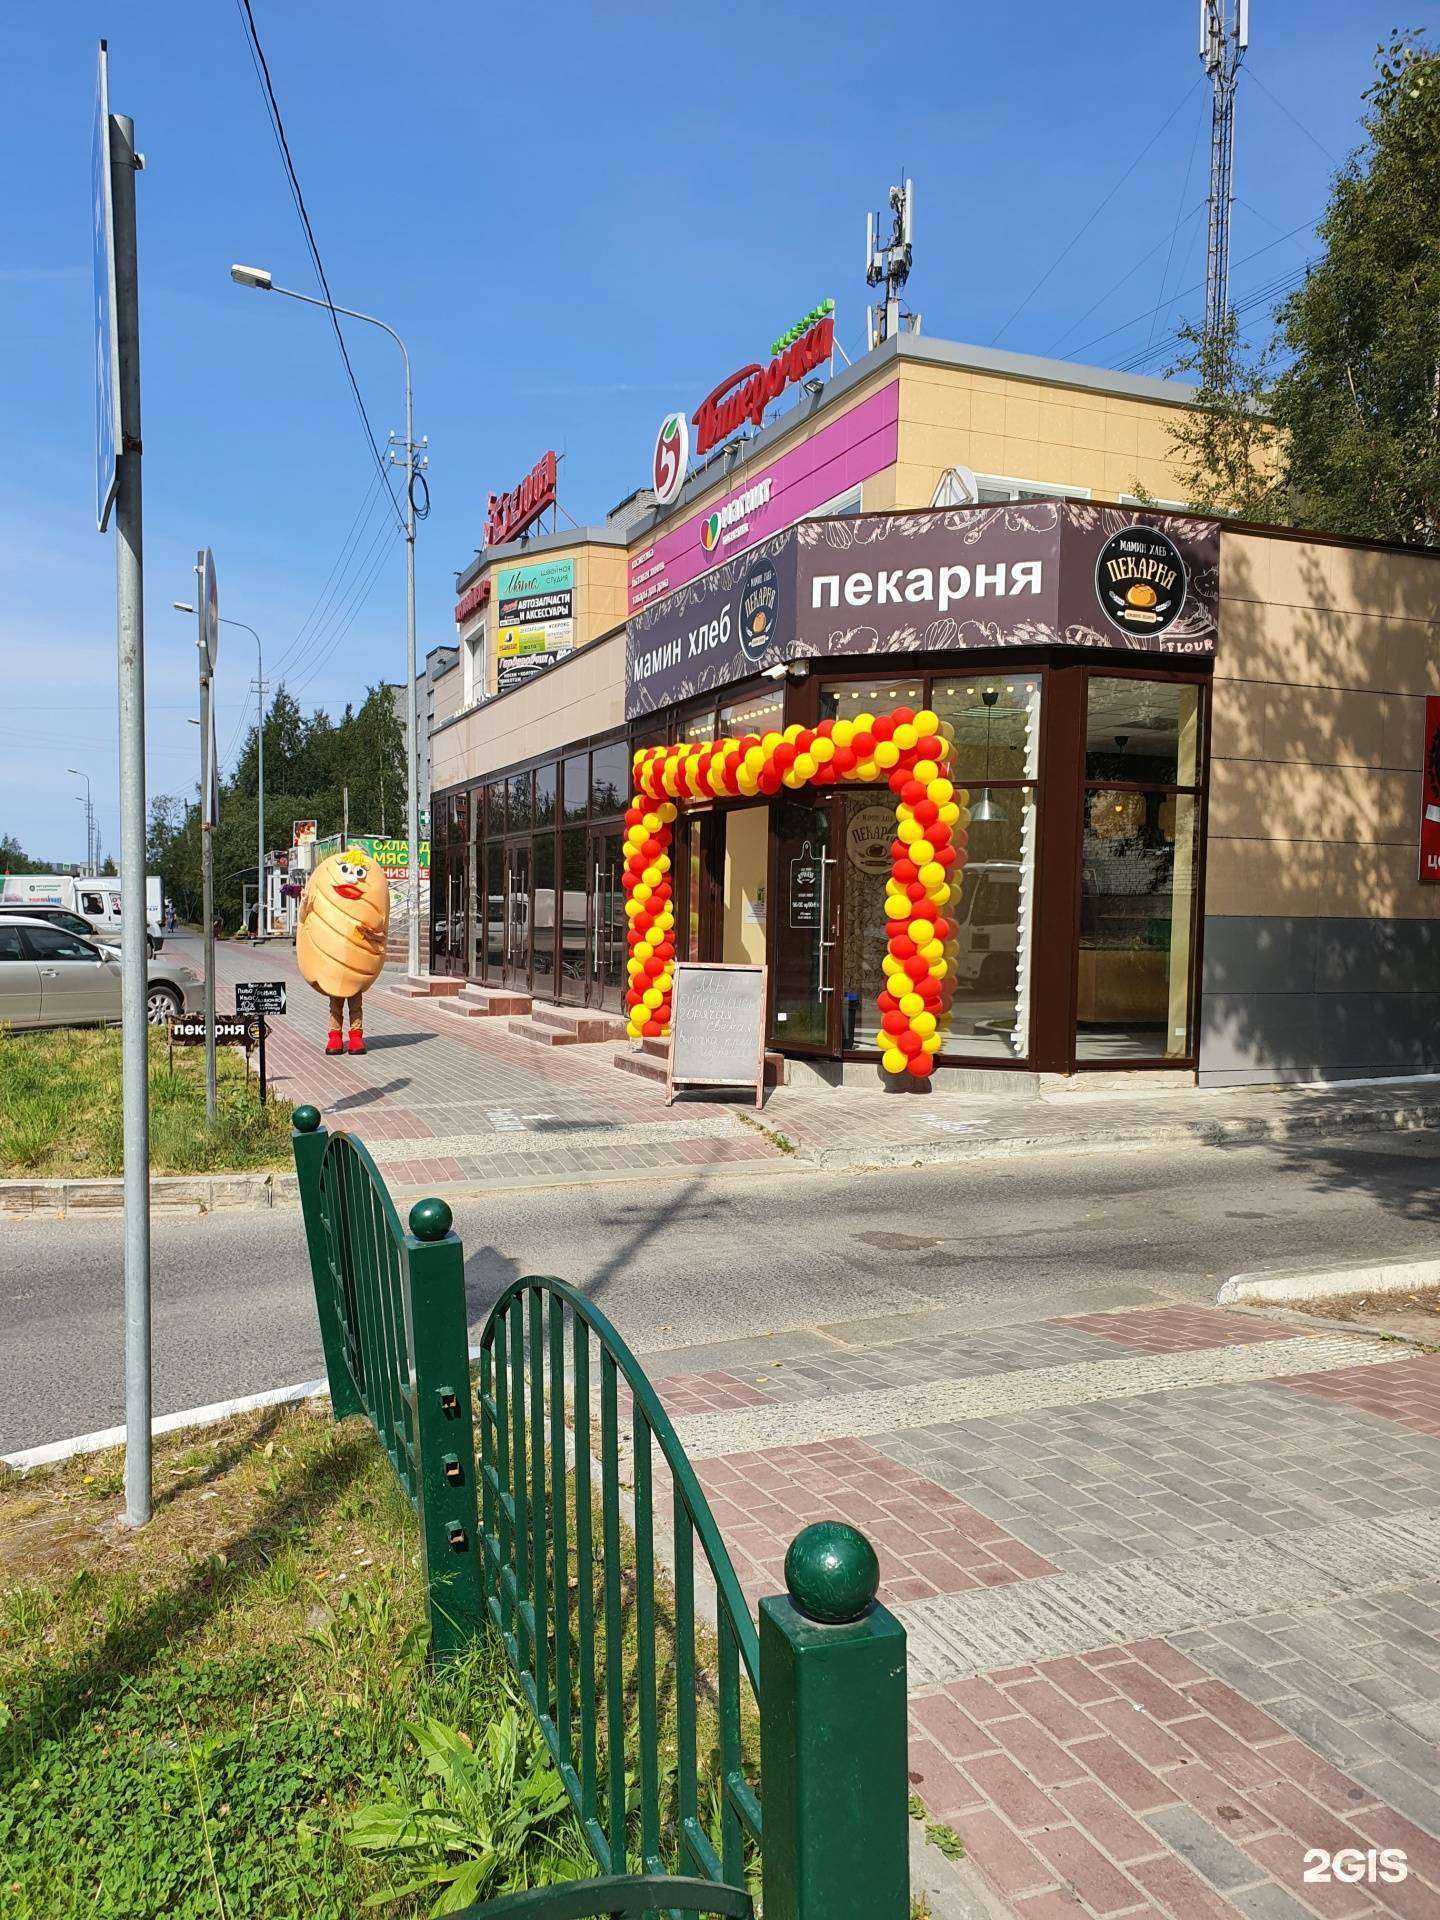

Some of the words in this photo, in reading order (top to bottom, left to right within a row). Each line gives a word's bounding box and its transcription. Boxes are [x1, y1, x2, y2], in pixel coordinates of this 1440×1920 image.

[1120, 540, 1147, 554] МАМИН
[1148, 545, 1167, 557] ХЛЕБ
[1106, 557, 1177, 590] ПЕКАРНЯ
[811, 560, 1043, 612] пекарня
[518, 593, 570, 610] АВТОЗАПЧАСТИ
[745, 586, 776, 619] ПЕКАРНЯ
[519, 611, 525, 620] И
[526, 605, 569, 620] АКСЕССУАРЫ
[633, 637, 682, 682] мамин
[688, 603, 731, 659] хлеб
[1166, 638, 1215, 653] FLOUR
[174, 1024, 245, 1038] пекрня
